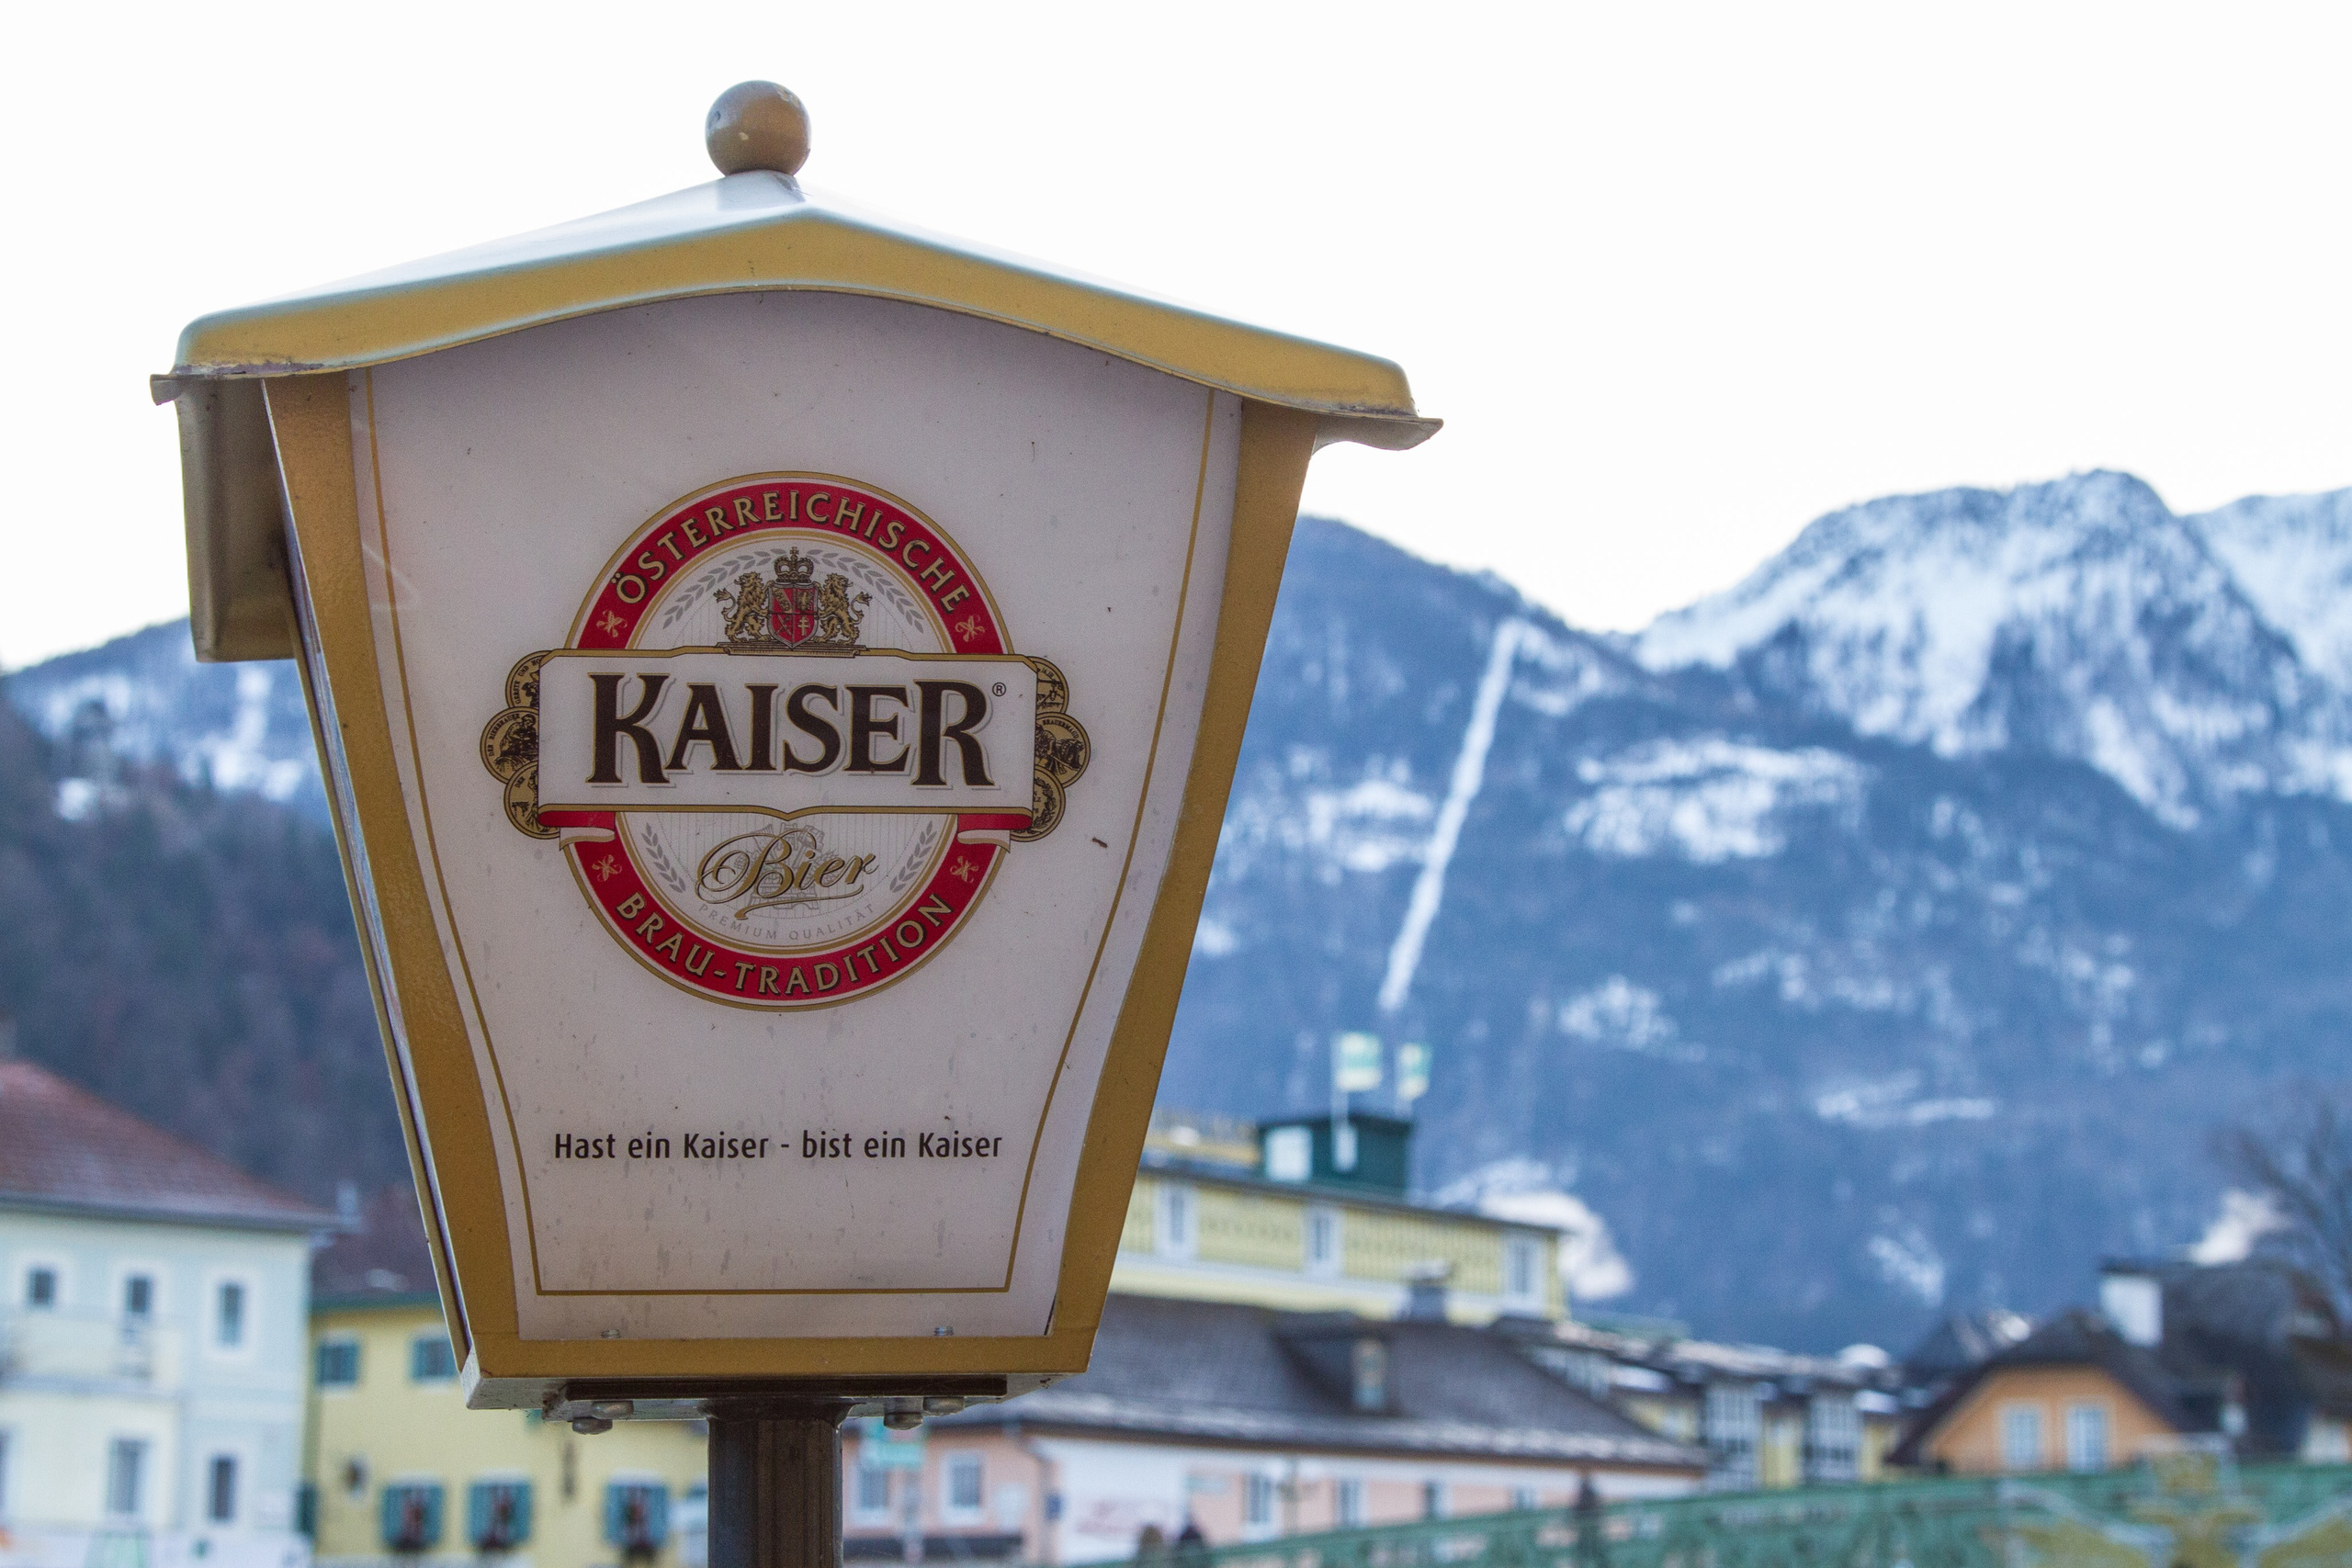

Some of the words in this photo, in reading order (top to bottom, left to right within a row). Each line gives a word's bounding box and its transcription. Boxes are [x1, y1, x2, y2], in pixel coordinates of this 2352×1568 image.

[611, 490, 971, 615] ÖSTERREICHISCHE
[585, 672, 996, 786] KAISER
[695, 829, 880, 920] Bier
[698, 903, 776, 940] PREMIUM
[788, 903, 874, 941] QUALITÄT
[615, 891, 956, 996] BRAU-TRADITION
[554, 1134, 616, 1158] Hast
[628, 1131, 670, 1158] ein
[684, 1131, 769, 1158] Kaiser
[802, 1130, 853, 1157] bist
[864, 1131, 905, 1157] ein
[919, 1130, 1002, 1157] Kaiser
